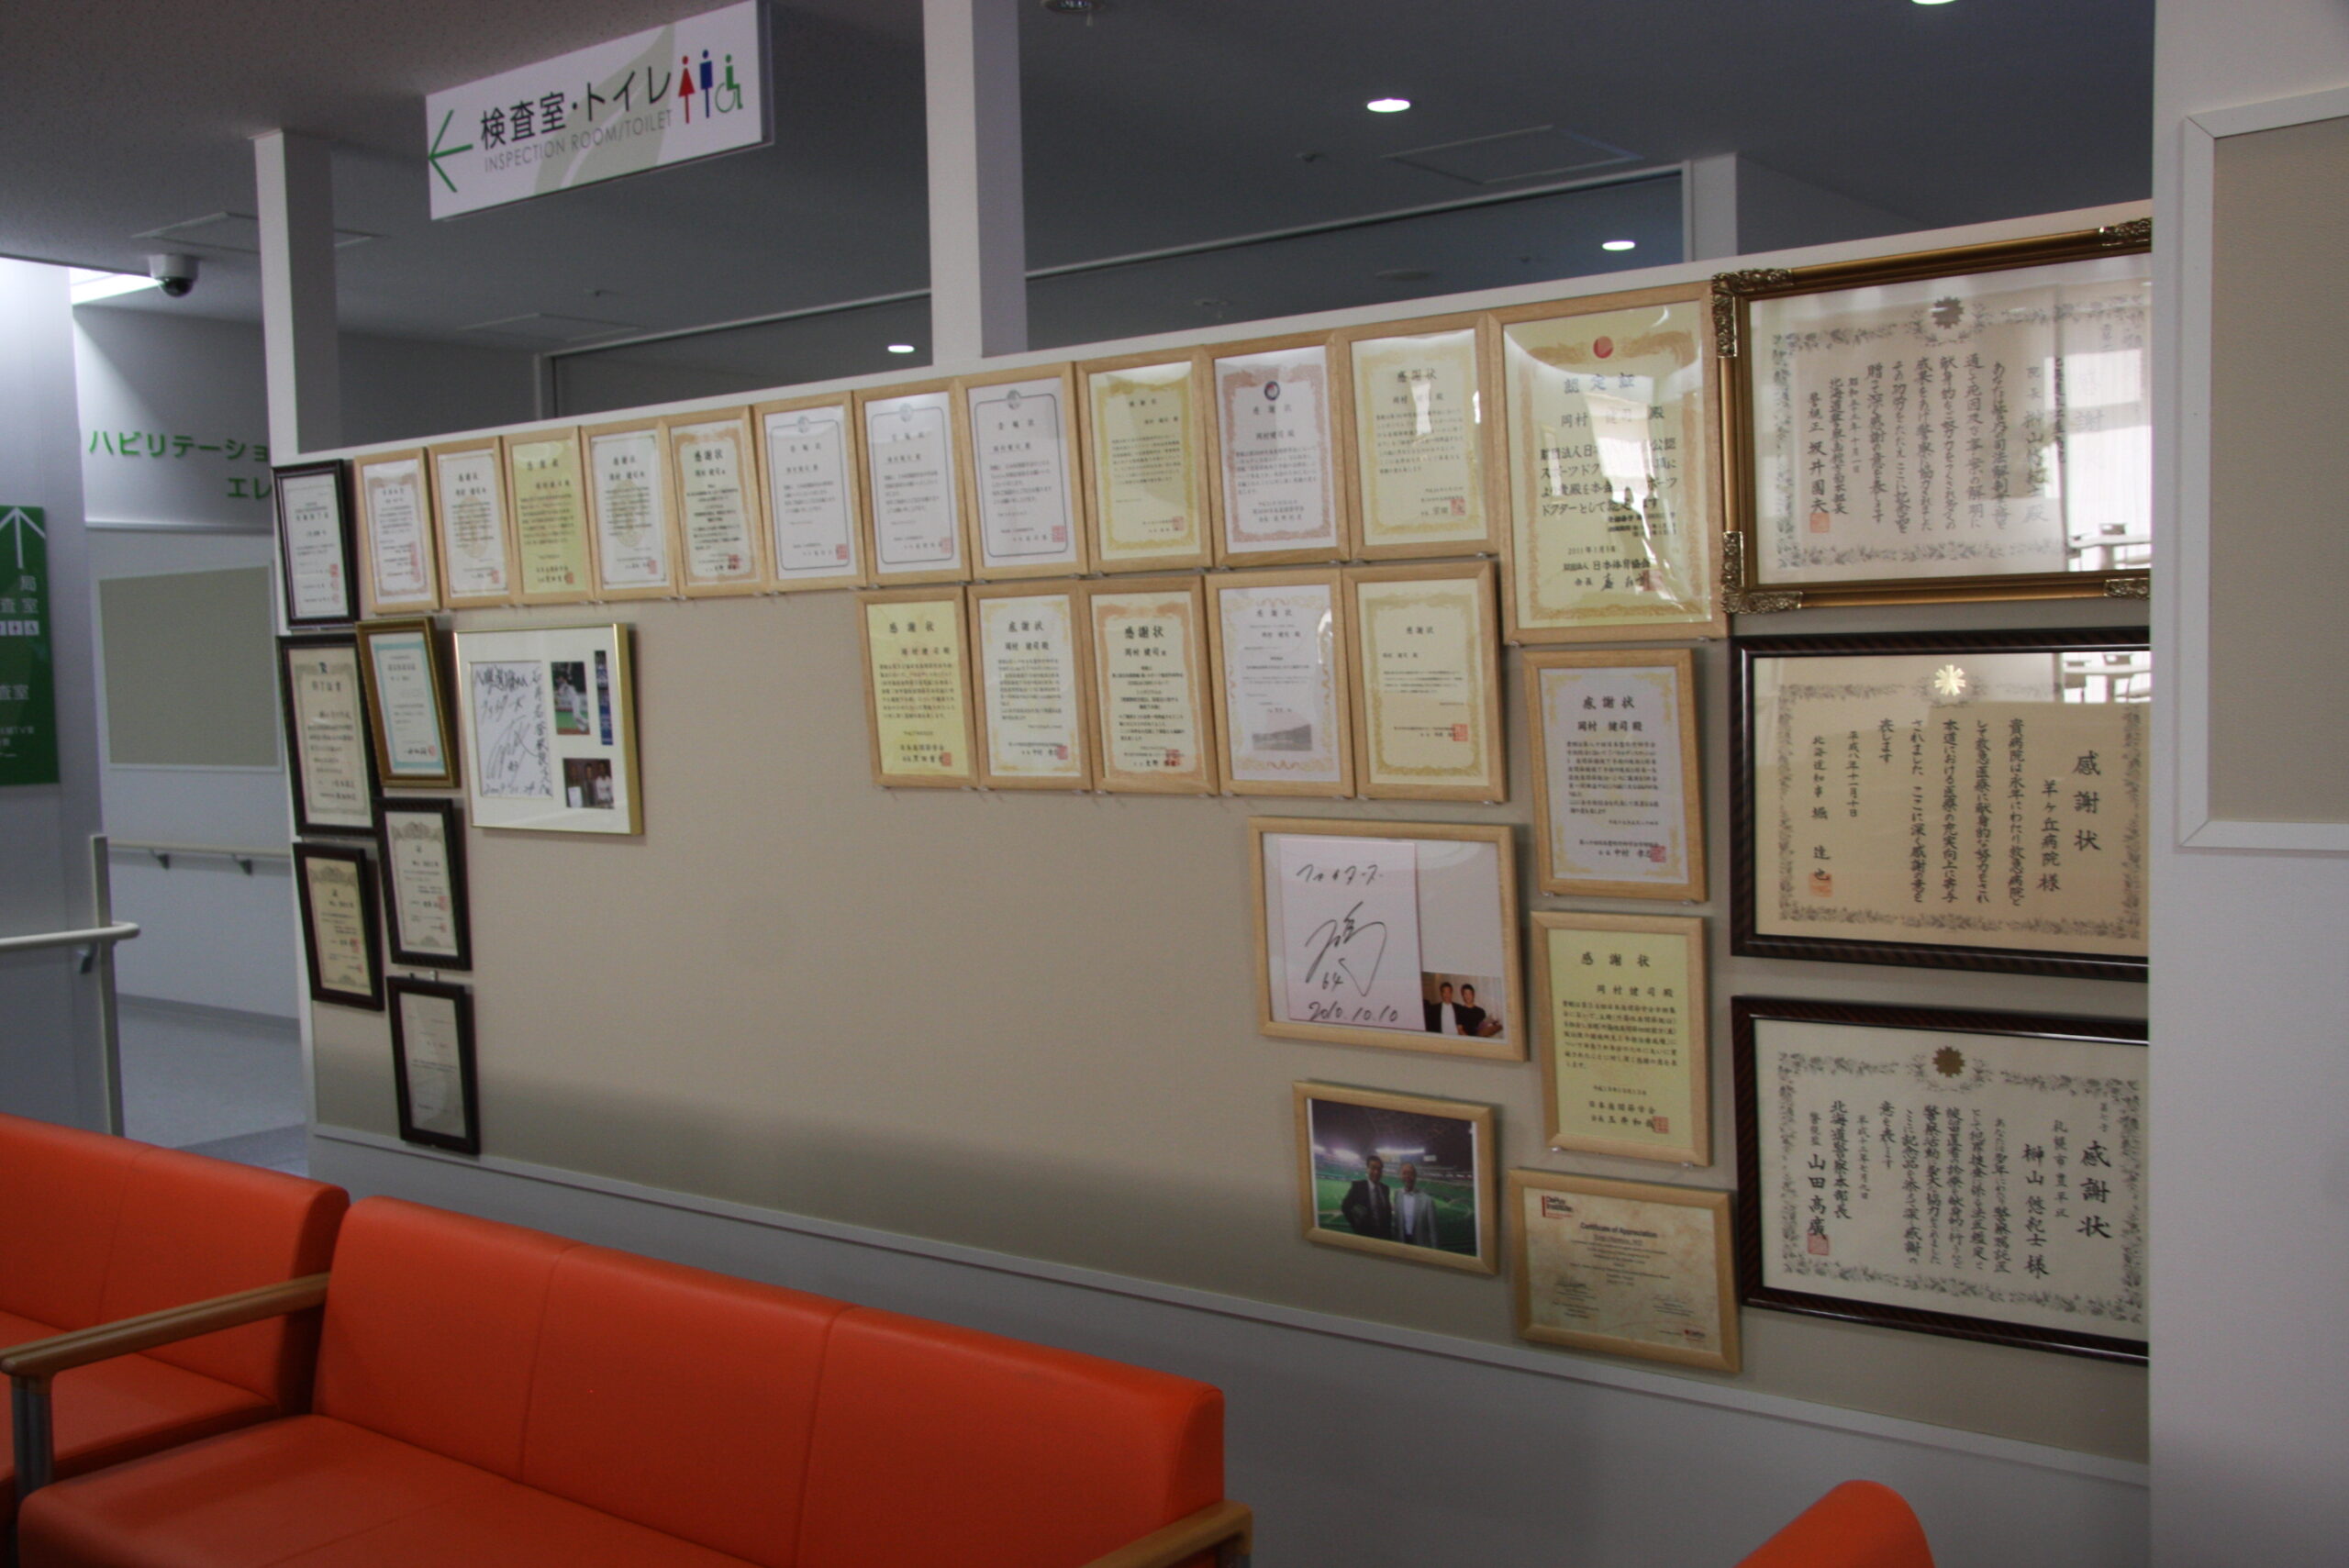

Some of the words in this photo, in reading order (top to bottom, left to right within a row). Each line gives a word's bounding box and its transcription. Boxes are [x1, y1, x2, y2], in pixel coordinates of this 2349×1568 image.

[481, 65, 672, 150] 検査室・トイレ
[484, 139, 566, 173] INSPECTION
[571, 109, 674, 151] ROOM/TOILET
[1564, 372, 1635, 394] 認定証
[1561, 412, 1588, 428] 岡村
[1125, 625, 1164, 639] 感謝状
[1583, 695, 1635, 709] 感謝状
[1877, 717, 1895, 763] 表します
[1811, 735, 1828, 798] 北海道知事
[2072, 749, 2102, 851] 感謝状
[1581, 951, 1651, 967] 感謝状
[1830, 1100, 1852, 1219] 北海道警察本部長
[2076, 1140, 2113, 1240] 感謝状
[1580, 1221, 1610, 1233] Certificate
[1620, 1228, 1658, 1238] Appreciation
